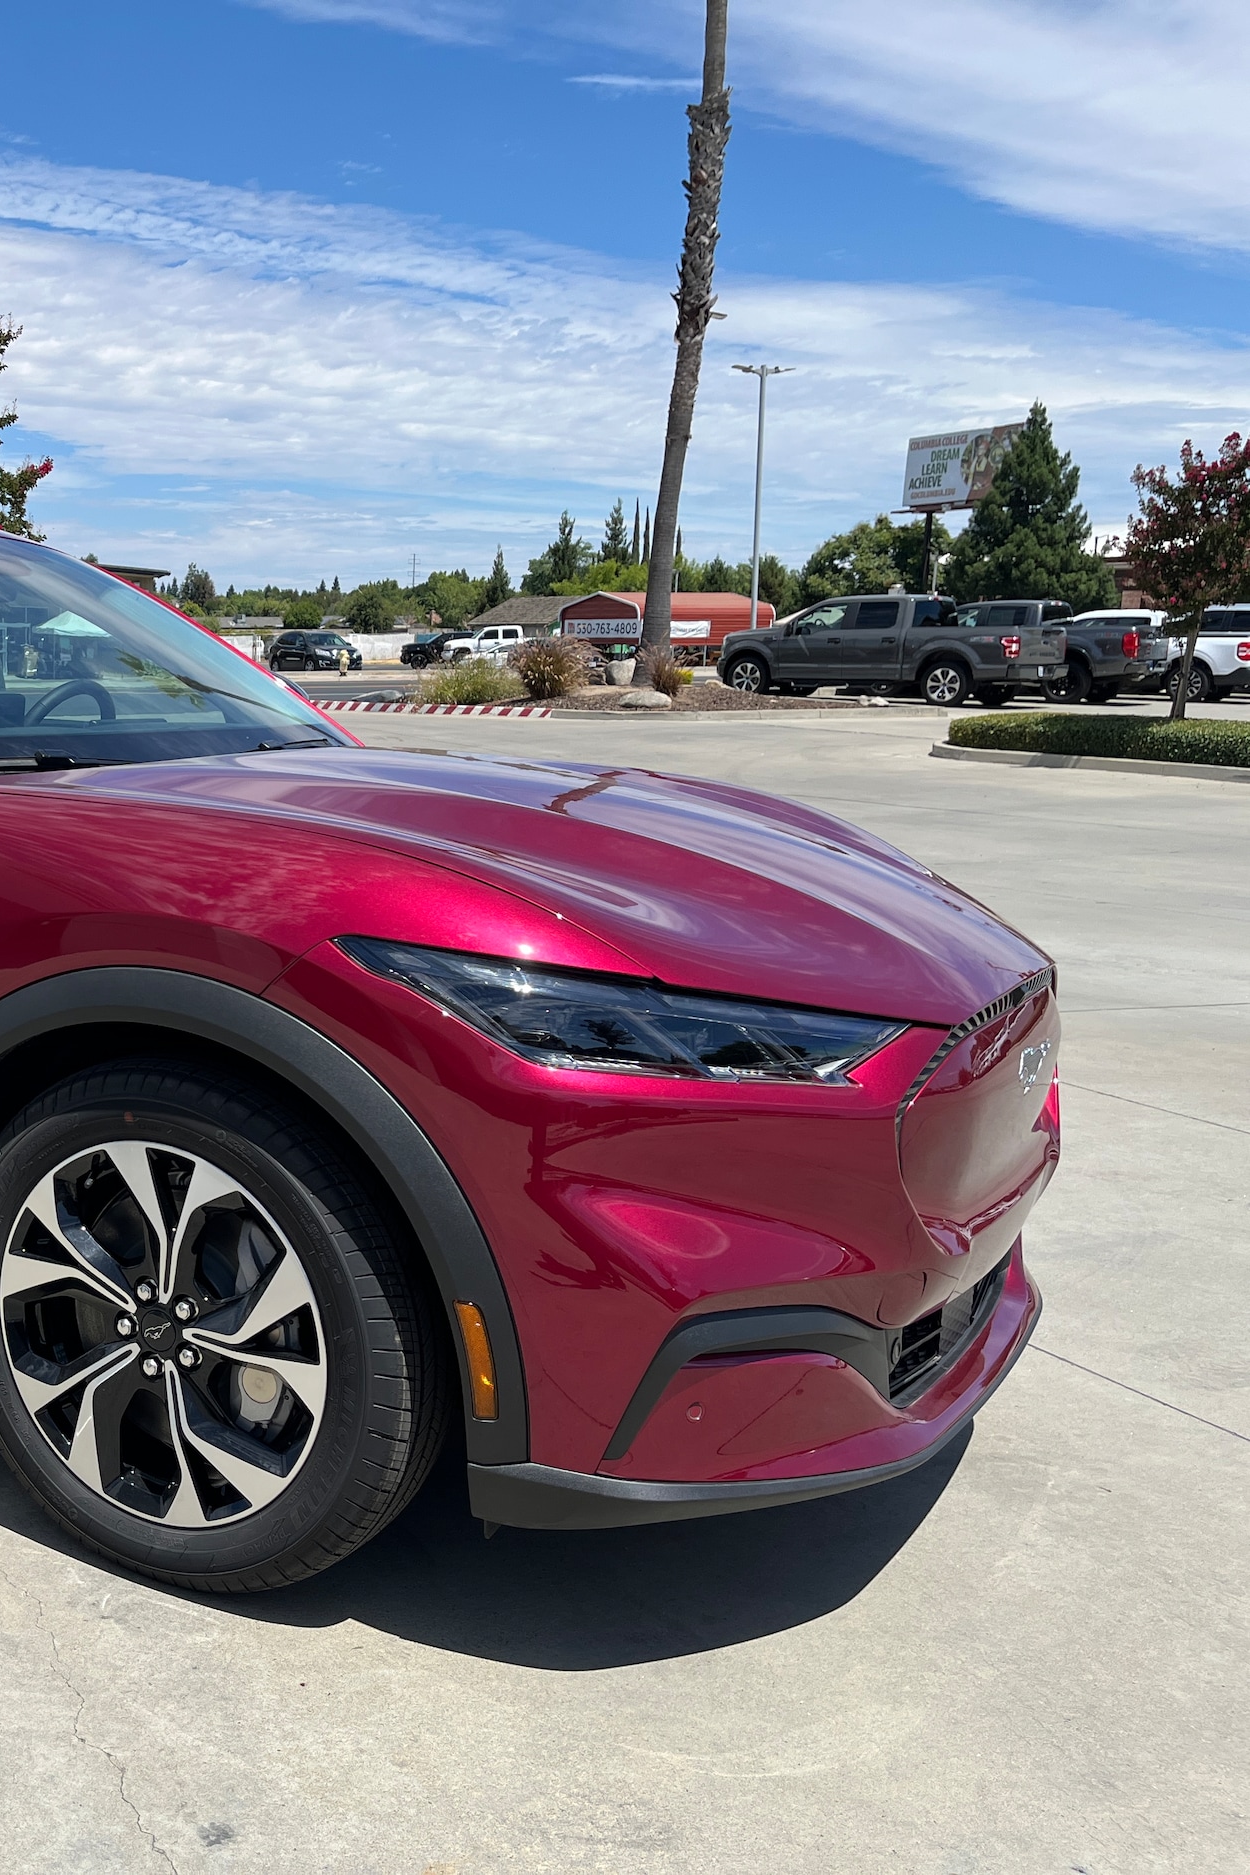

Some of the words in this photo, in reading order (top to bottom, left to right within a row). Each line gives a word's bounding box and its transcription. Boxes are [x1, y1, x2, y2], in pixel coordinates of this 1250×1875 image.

[942, 434, 968, 446] COLLEGE
[931, 447, 960, 462] DREAM
[921, 462, 948, 476] LEARN
[909, 475, 942, 490] ACHIEVE
[576, 622, 638, 634] 530-763-4809
